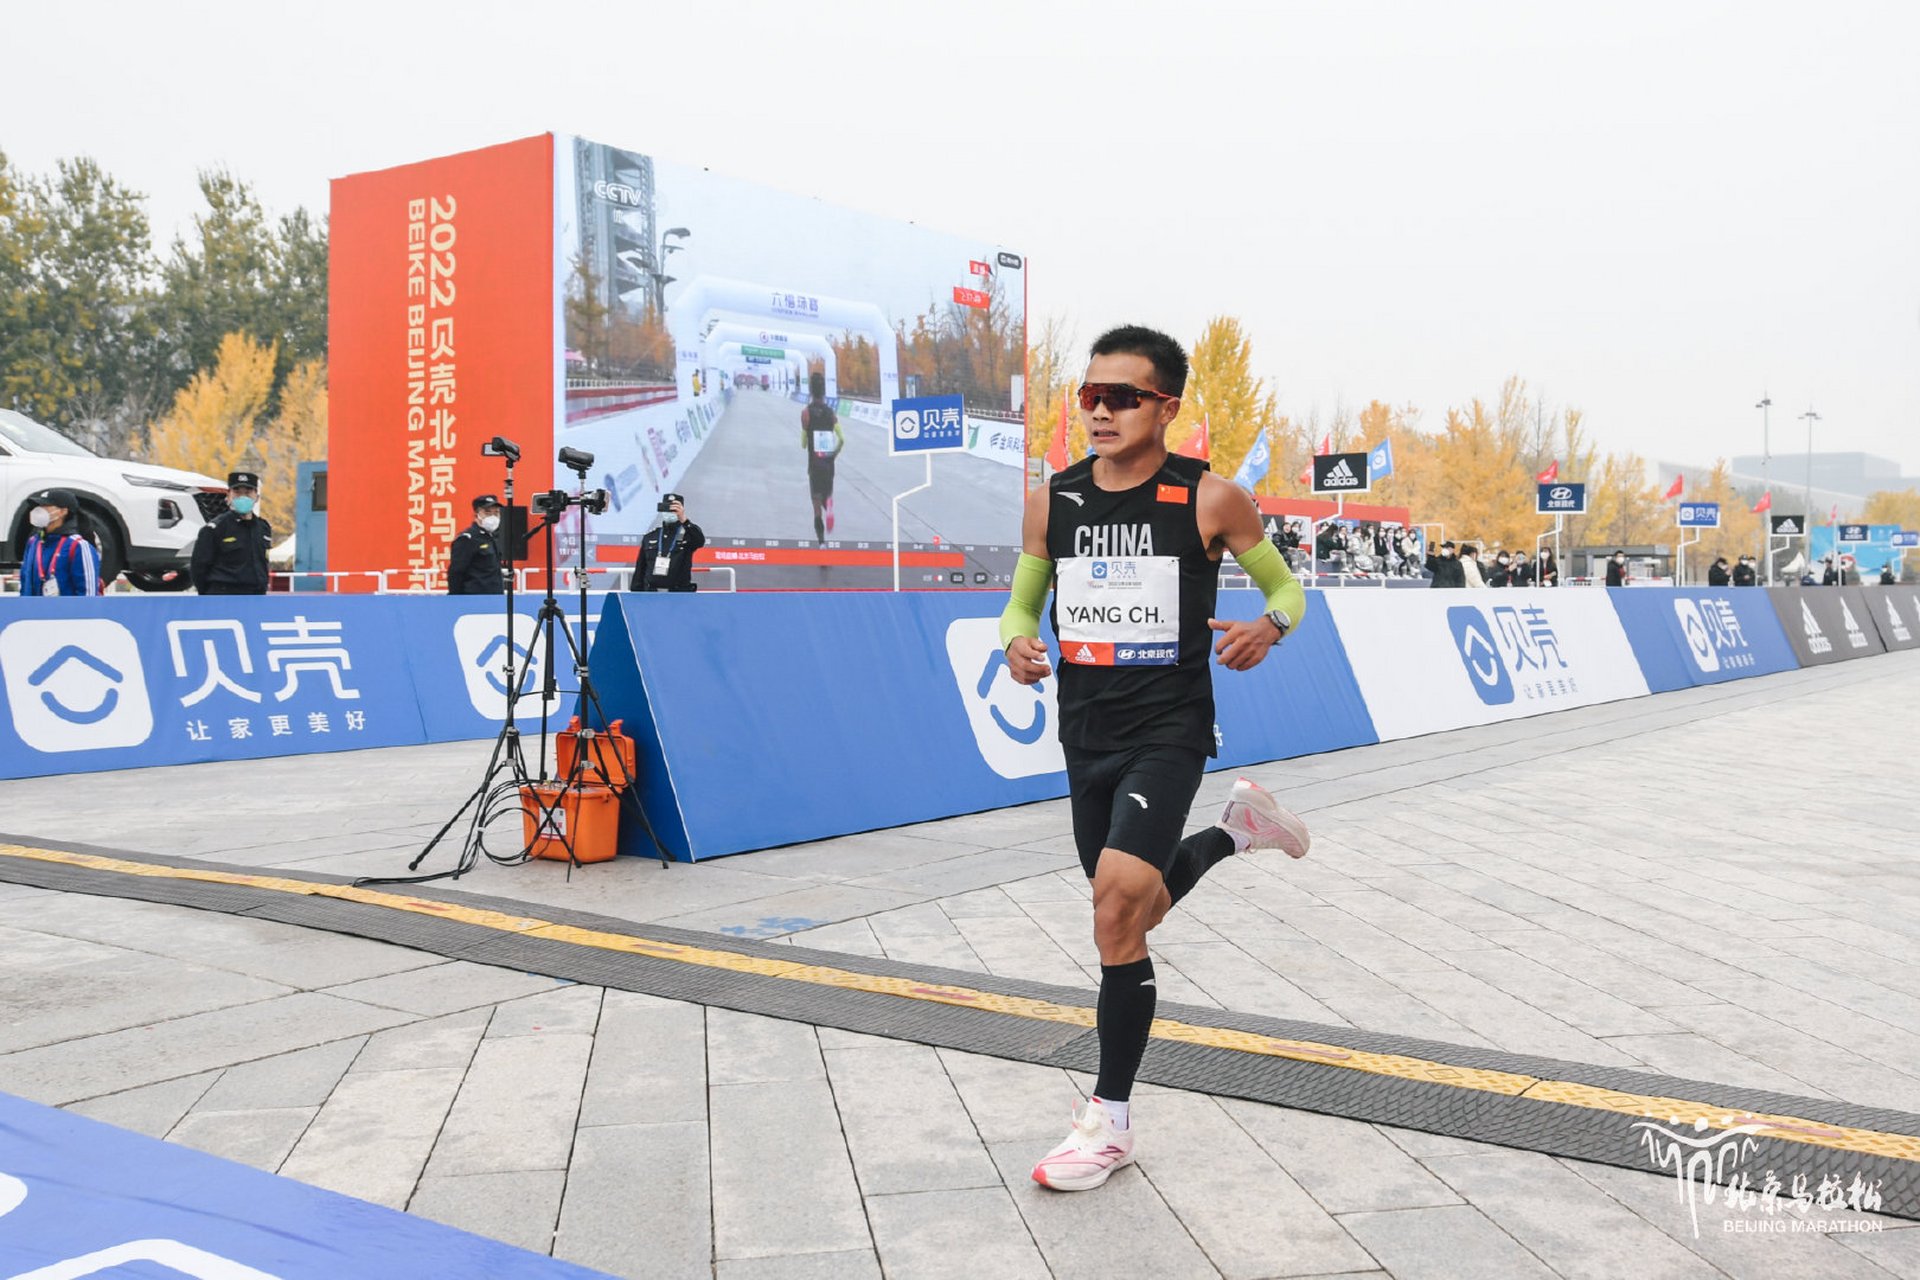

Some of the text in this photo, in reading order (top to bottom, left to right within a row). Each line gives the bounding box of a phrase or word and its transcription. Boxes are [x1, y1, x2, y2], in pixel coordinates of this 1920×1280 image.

[594, 180, 641, 206] CCTV
[408, 198, 425, 298] BEIKE
[408, 304, 425, 431] BEIJING
[923, 407, 960, 430] 贝壳
[1323, 477, 1358, 486] adidas
[1695, 507, 1716, 519] 贝壳
[1074, 523, 1154, 557] CHINA
[1111, 561, 1137, 575] 贝壳
[1066, 606, 1165, 623] YANG CH.
[1700, 598, 1748, 650] 贝壳
[1492, 603, 1568, 672] 贝壳
[166, 615, 360, 707] 贝壳
[1138, 649, 1175, 659] 北京现代
[186, 710, 367, 742] 让家更美好
